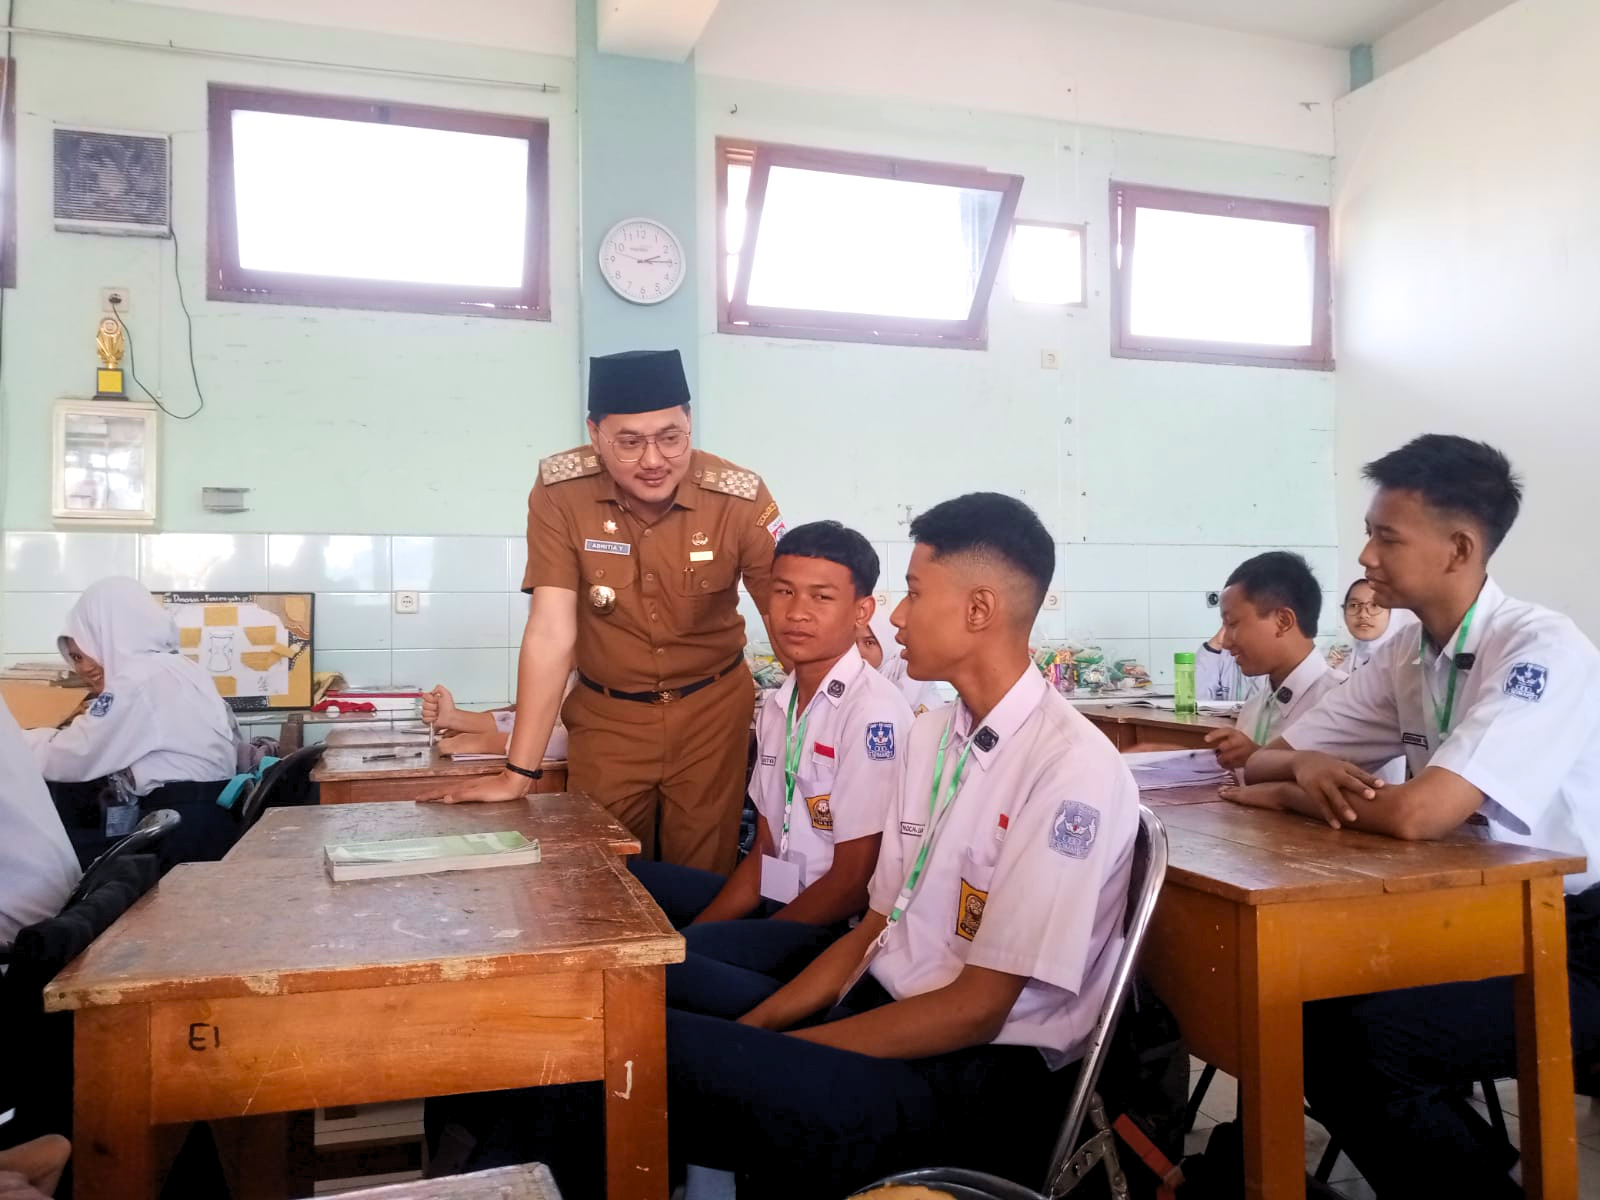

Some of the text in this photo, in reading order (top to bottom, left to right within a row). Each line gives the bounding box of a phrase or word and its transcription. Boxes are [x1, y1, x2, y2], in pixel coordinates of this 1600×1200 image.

[623, 231, 633, 241] 11
[636, 229, 646, 239] 12
[614, 242, 625, 253] 10
[663, 244, 669, 254] 2
[610, 255, 616, 263] 9
[615, 270, 622, 280] 8
[640, 286, 646, 295] 6
[655, 282, 661, 292] 5
